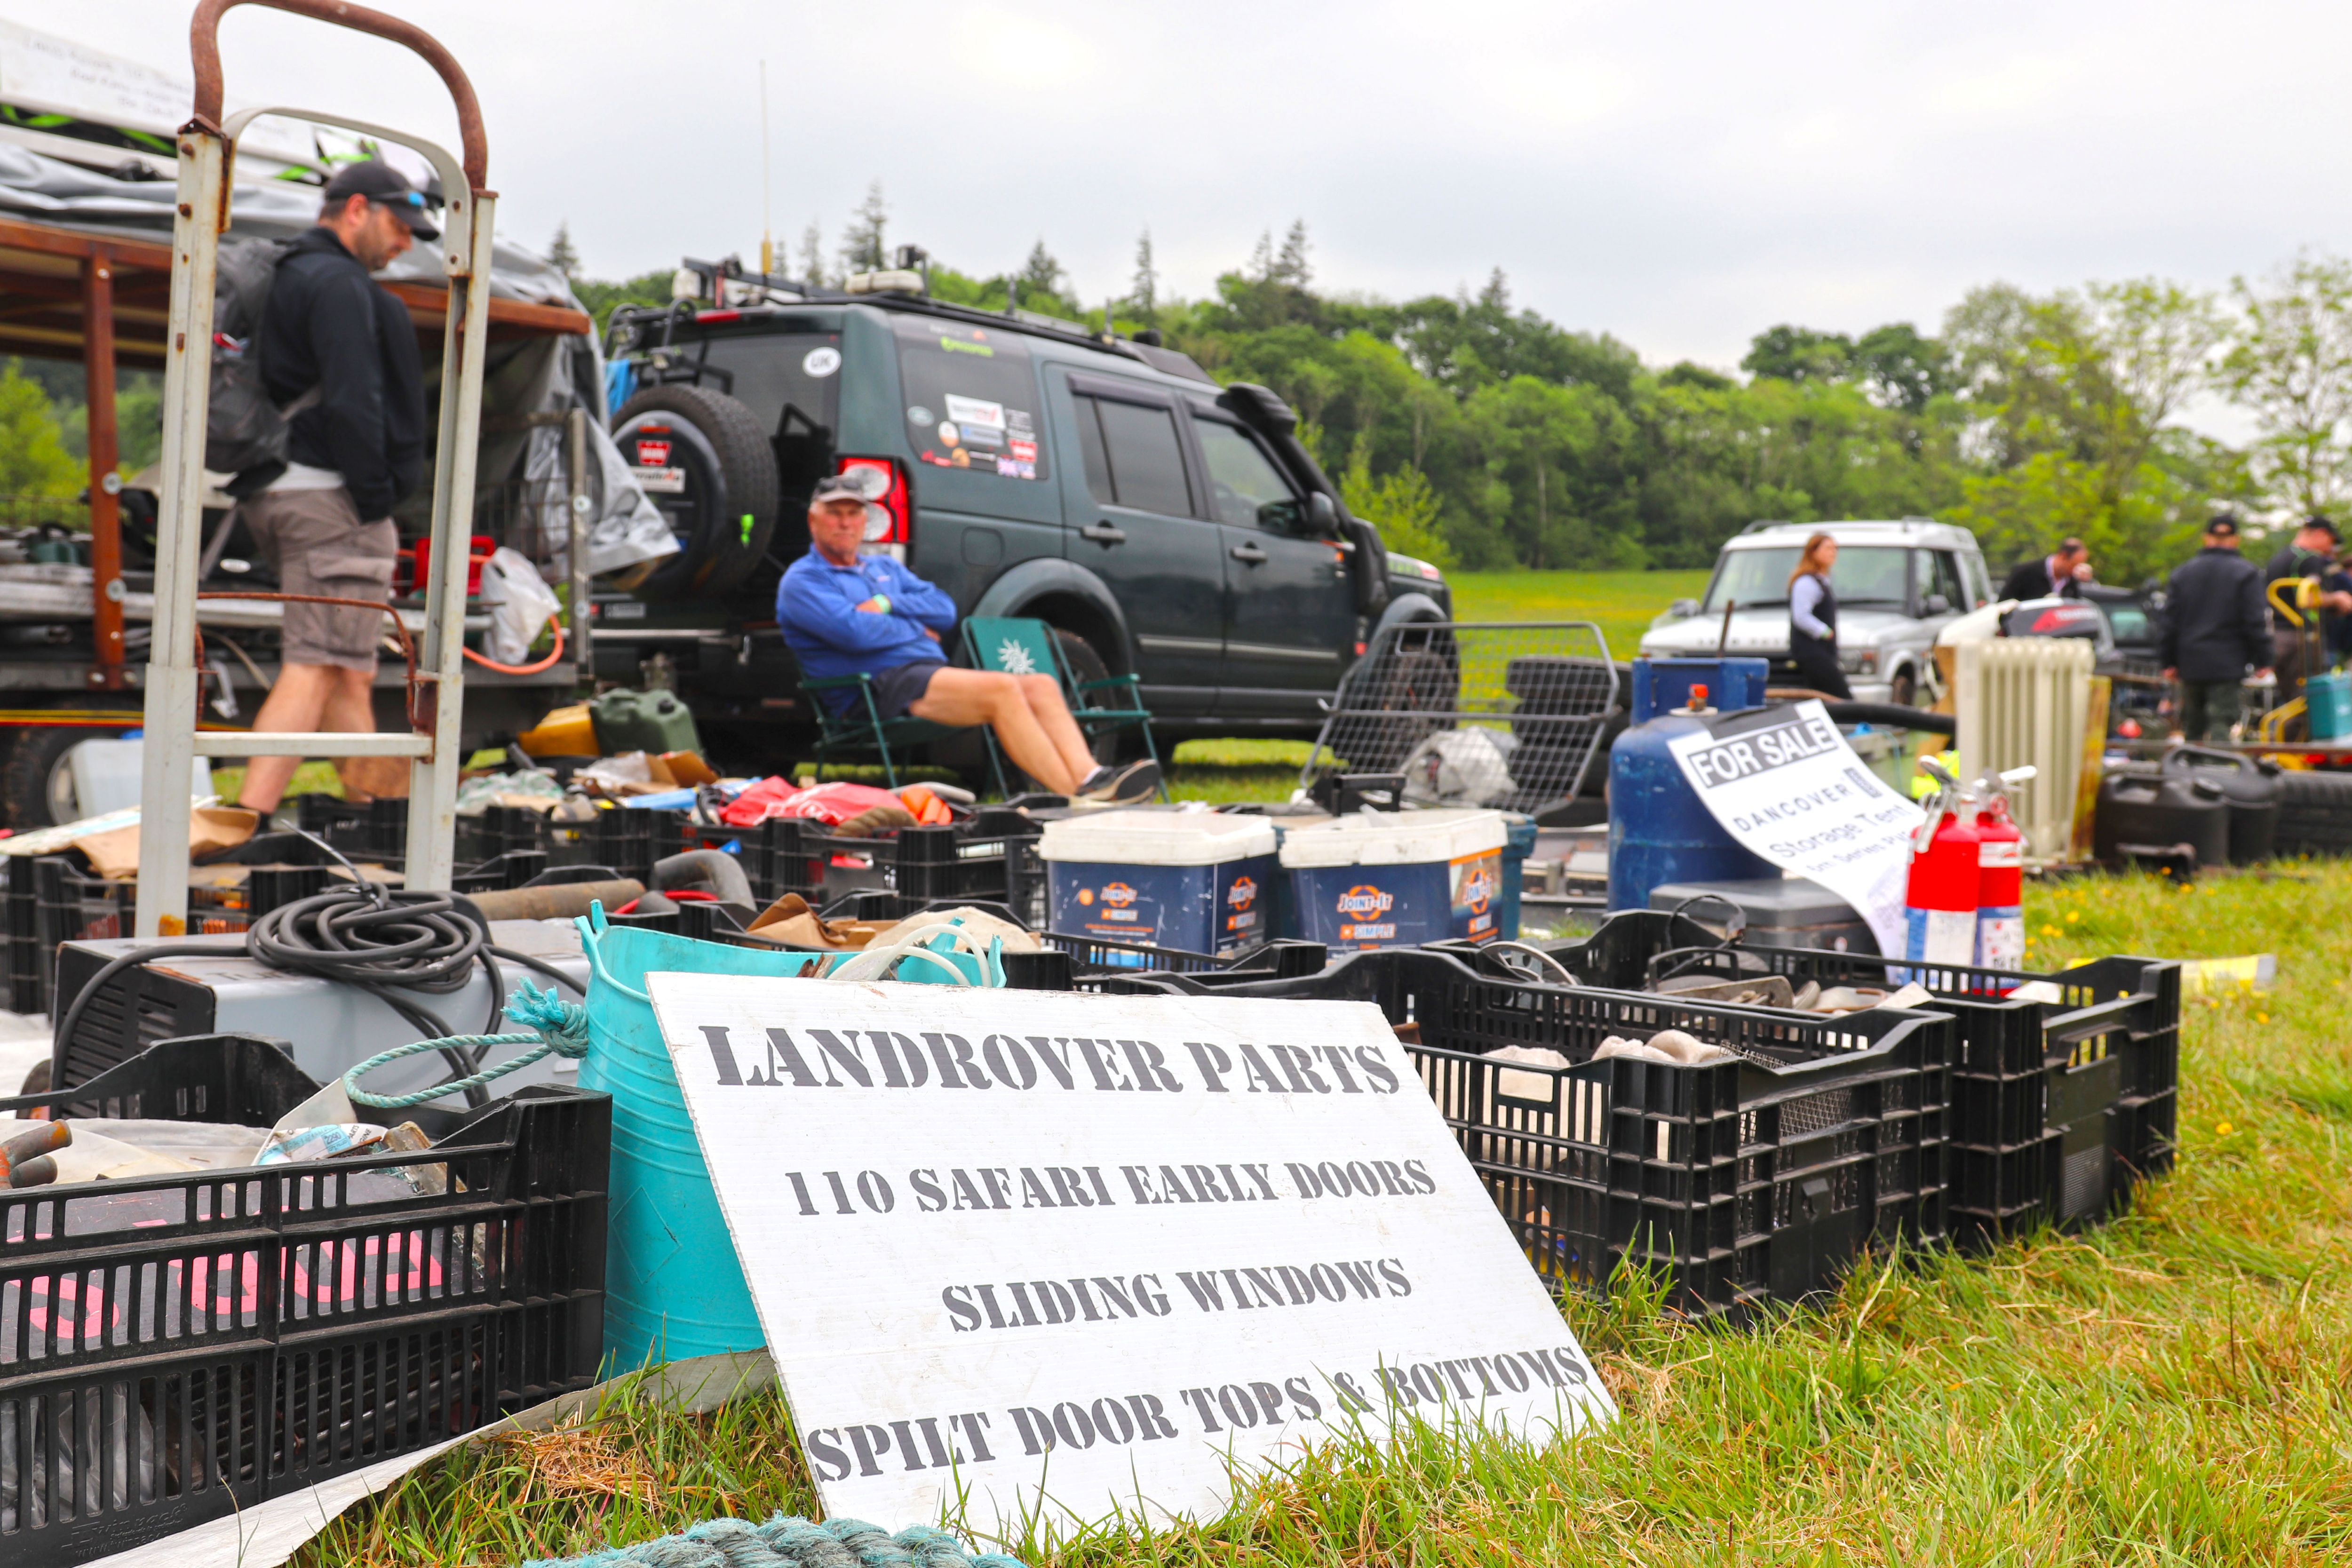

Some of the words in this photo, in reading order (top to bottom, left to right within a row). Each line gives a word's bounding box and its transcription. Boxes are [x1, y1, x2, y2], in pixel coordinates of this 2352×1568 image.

[810, 353, 834, 368] UK
[1692, 742, 1762, 786] FOR
[1756, 718, 1835, 766] SALE
[1733, 783, 1854, 832] DANCOVER
[1769, 823, 1862, 858] Storage
[1854, 804, 1911, 827] Tent
[1353, 923, 1396, 939] SIMPLE
[698, 1025, 1183, 1092] LANDROVER
[1183, 1042, 1399, 1094] PARTS
[785, 1170, 894, 1216] 110
[909, 1166, 1116, 1212] SAFARI
[1119, 1163, 1279, 1204] EARLY
[1283, 1159, 1436, 1199] DOORS
[942, 1272, 1172, 1332] SLIDING
[1176, 1258, 1412, 1312] WINDOWS
[807, 1413, 996, 1483] SPILT
[1007, 1394, 1179, 1456] DOOR
[1182, 1377, 1322, 1433] TOPS
[1334, 1371, 1376, 1415] &
[1375, 1347, 1588, 1410] BOTTOMS
